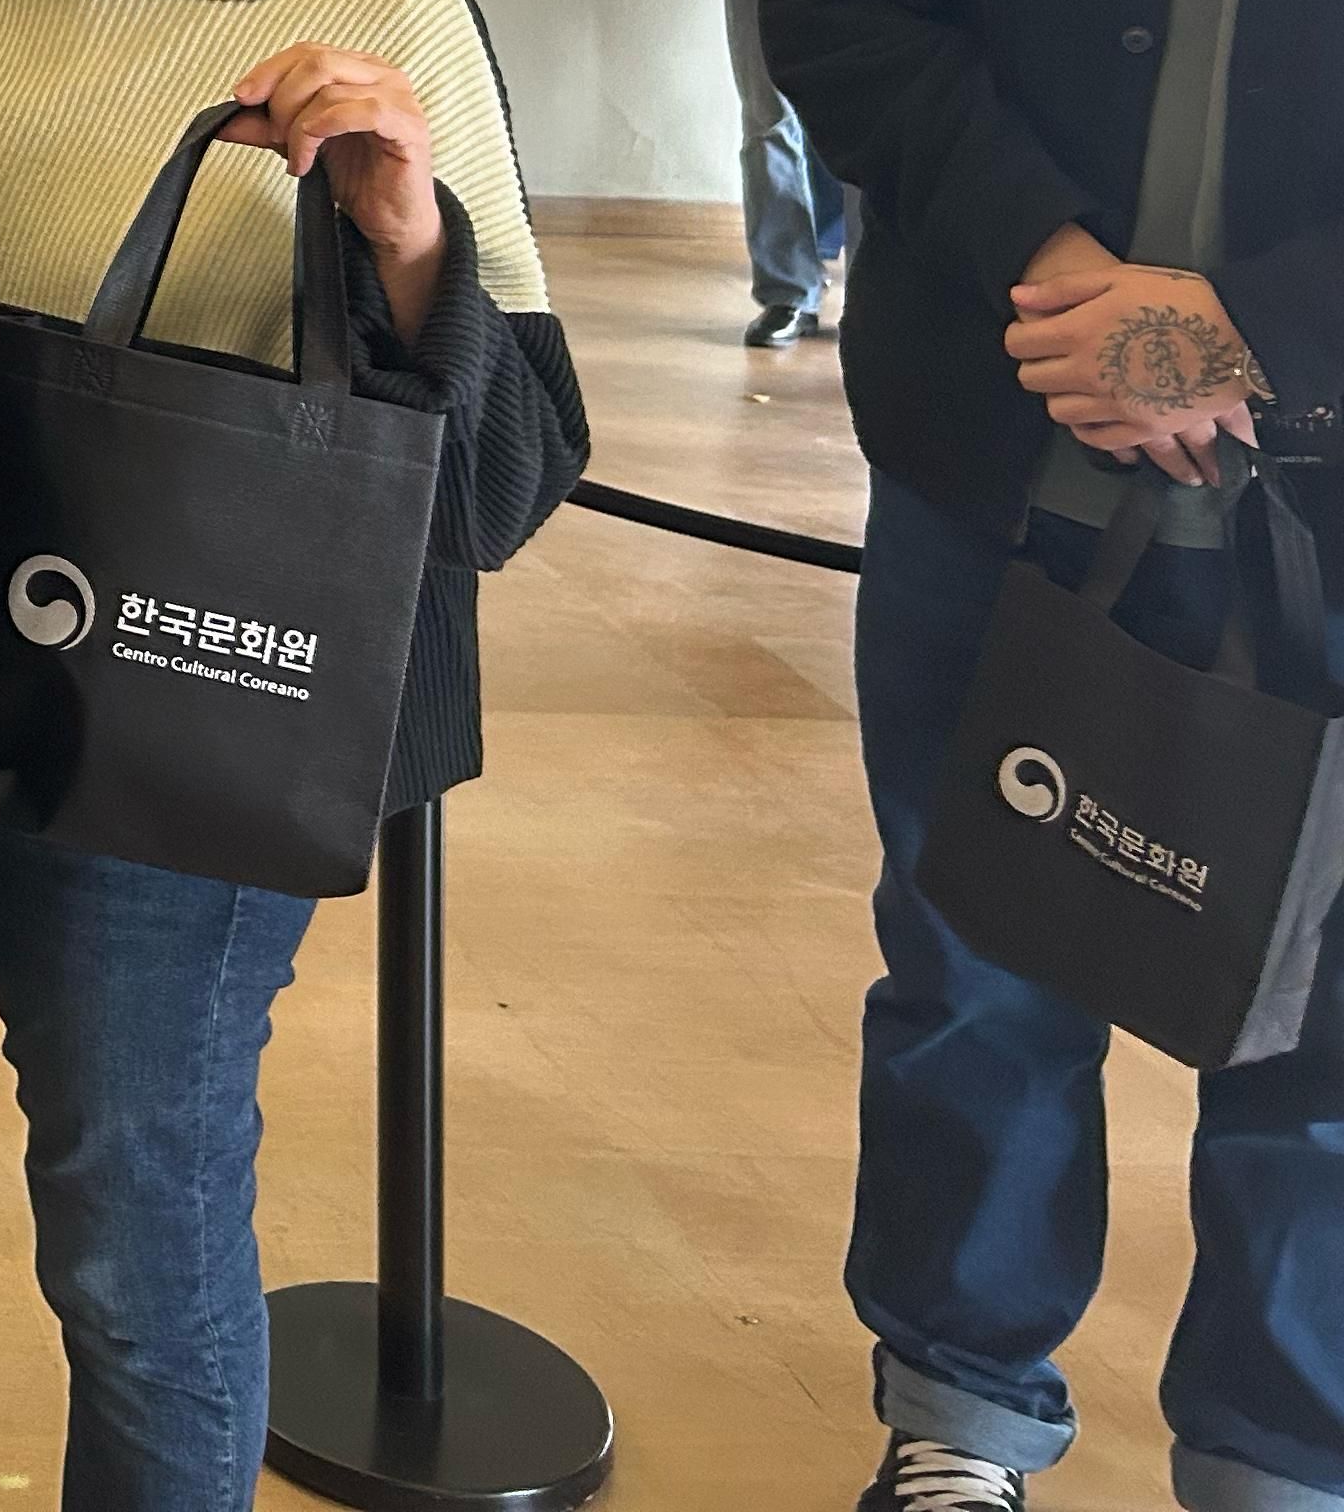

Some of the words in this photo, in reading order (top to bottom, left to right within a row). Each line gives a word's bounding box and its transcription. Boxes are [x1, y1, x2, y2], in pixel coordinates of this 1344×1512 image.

[112, 642, 168, 668] Centro
[171, 656, 237, 685] Cultural
[239, 672, 310, 701] Coreano
[116, 593, 318, 674] 한국문화원
[1075, 794, 1209, 894] 한국문화원
